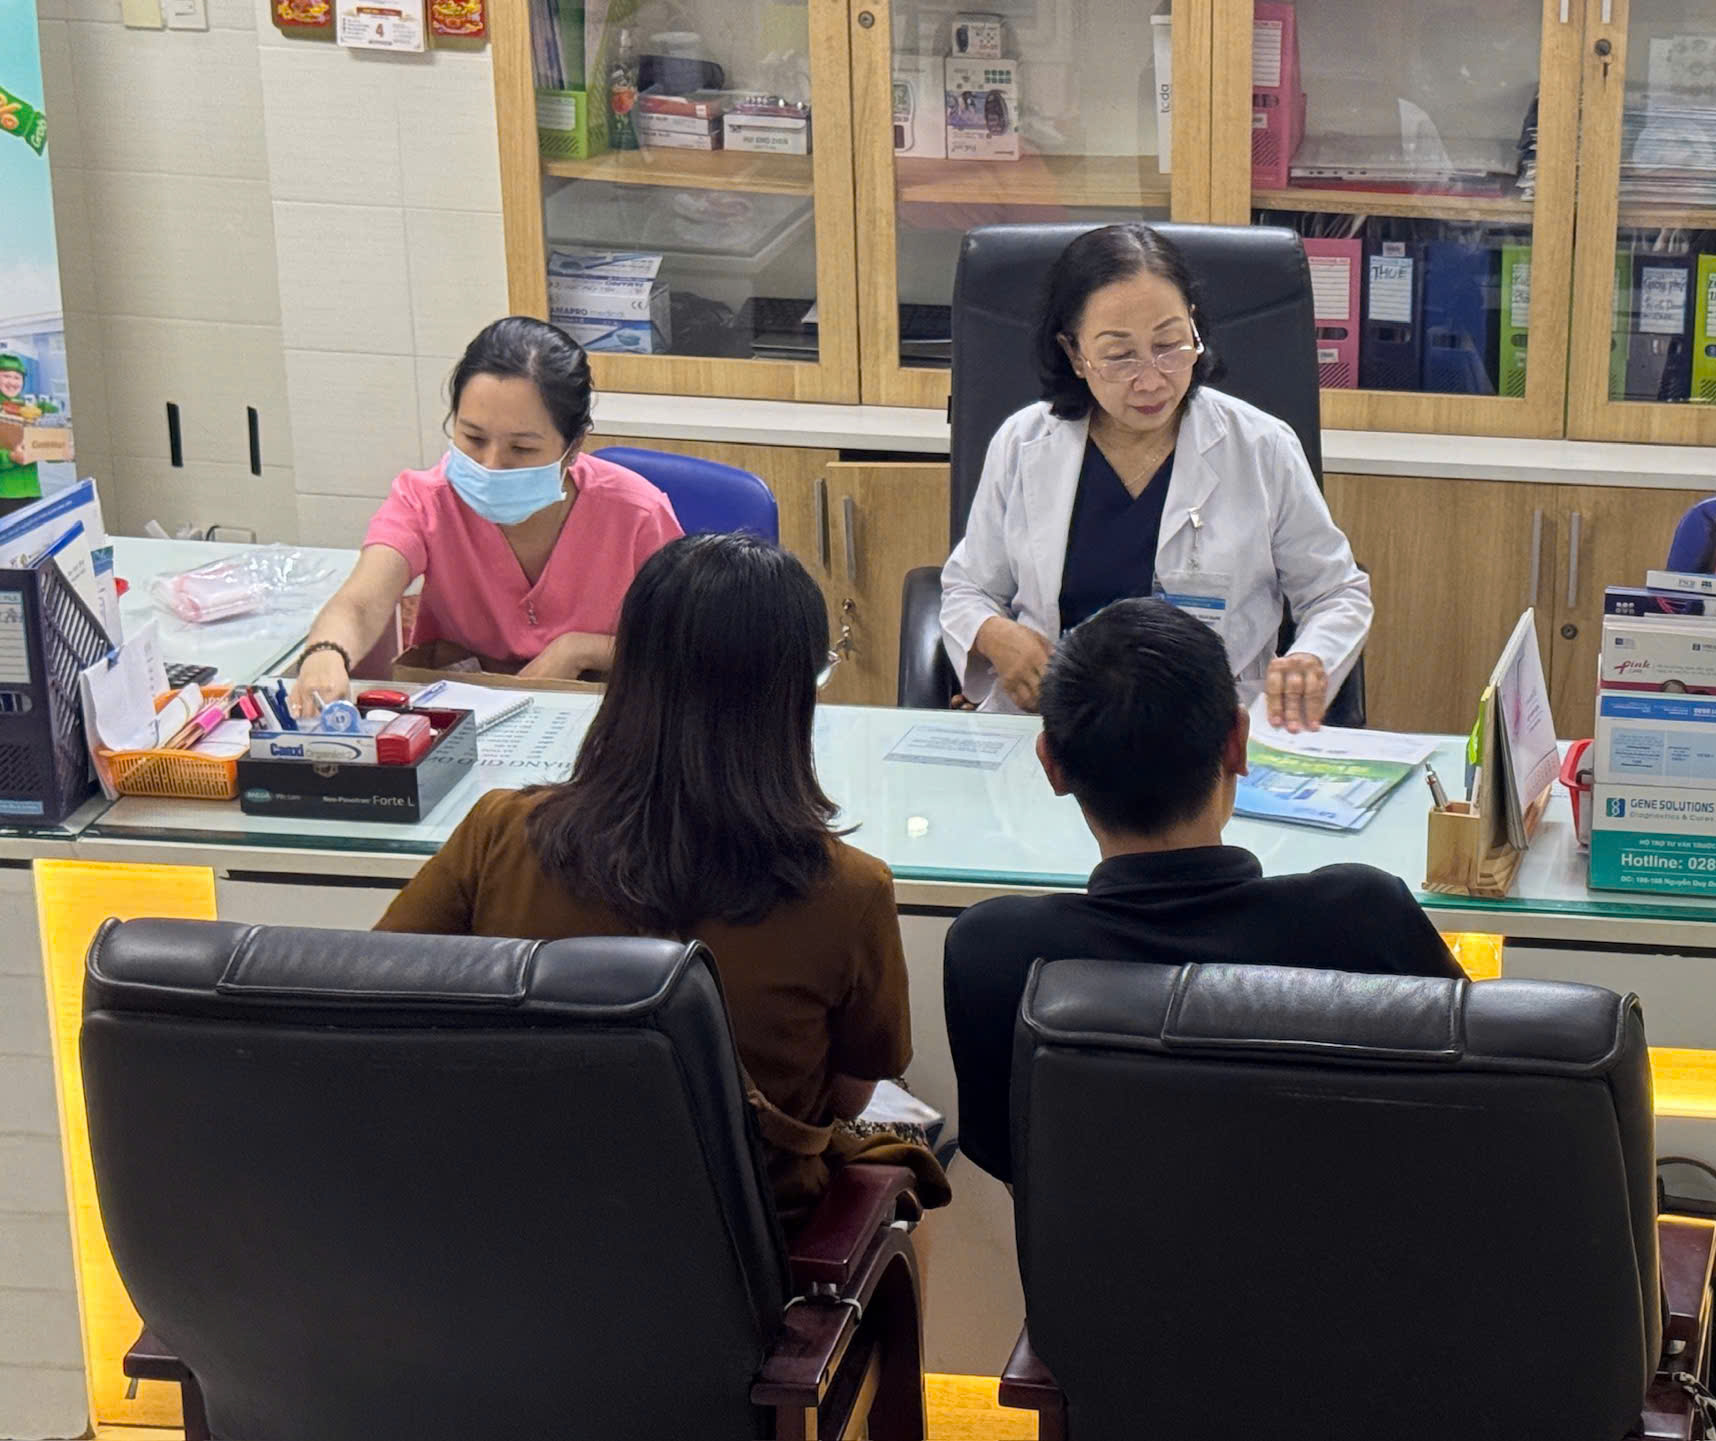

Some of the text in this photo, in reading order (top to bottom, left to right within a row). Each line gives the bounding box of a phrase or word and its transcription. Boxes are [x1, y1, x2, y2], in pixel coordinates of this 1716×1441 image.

[372, 795, 405, 807] Forte
[407, 796, 416, 808] L
[1630, 798, 1715, 813] GENE SOLUTIONS
[1621, 853, 1683, 870] Hotline:
